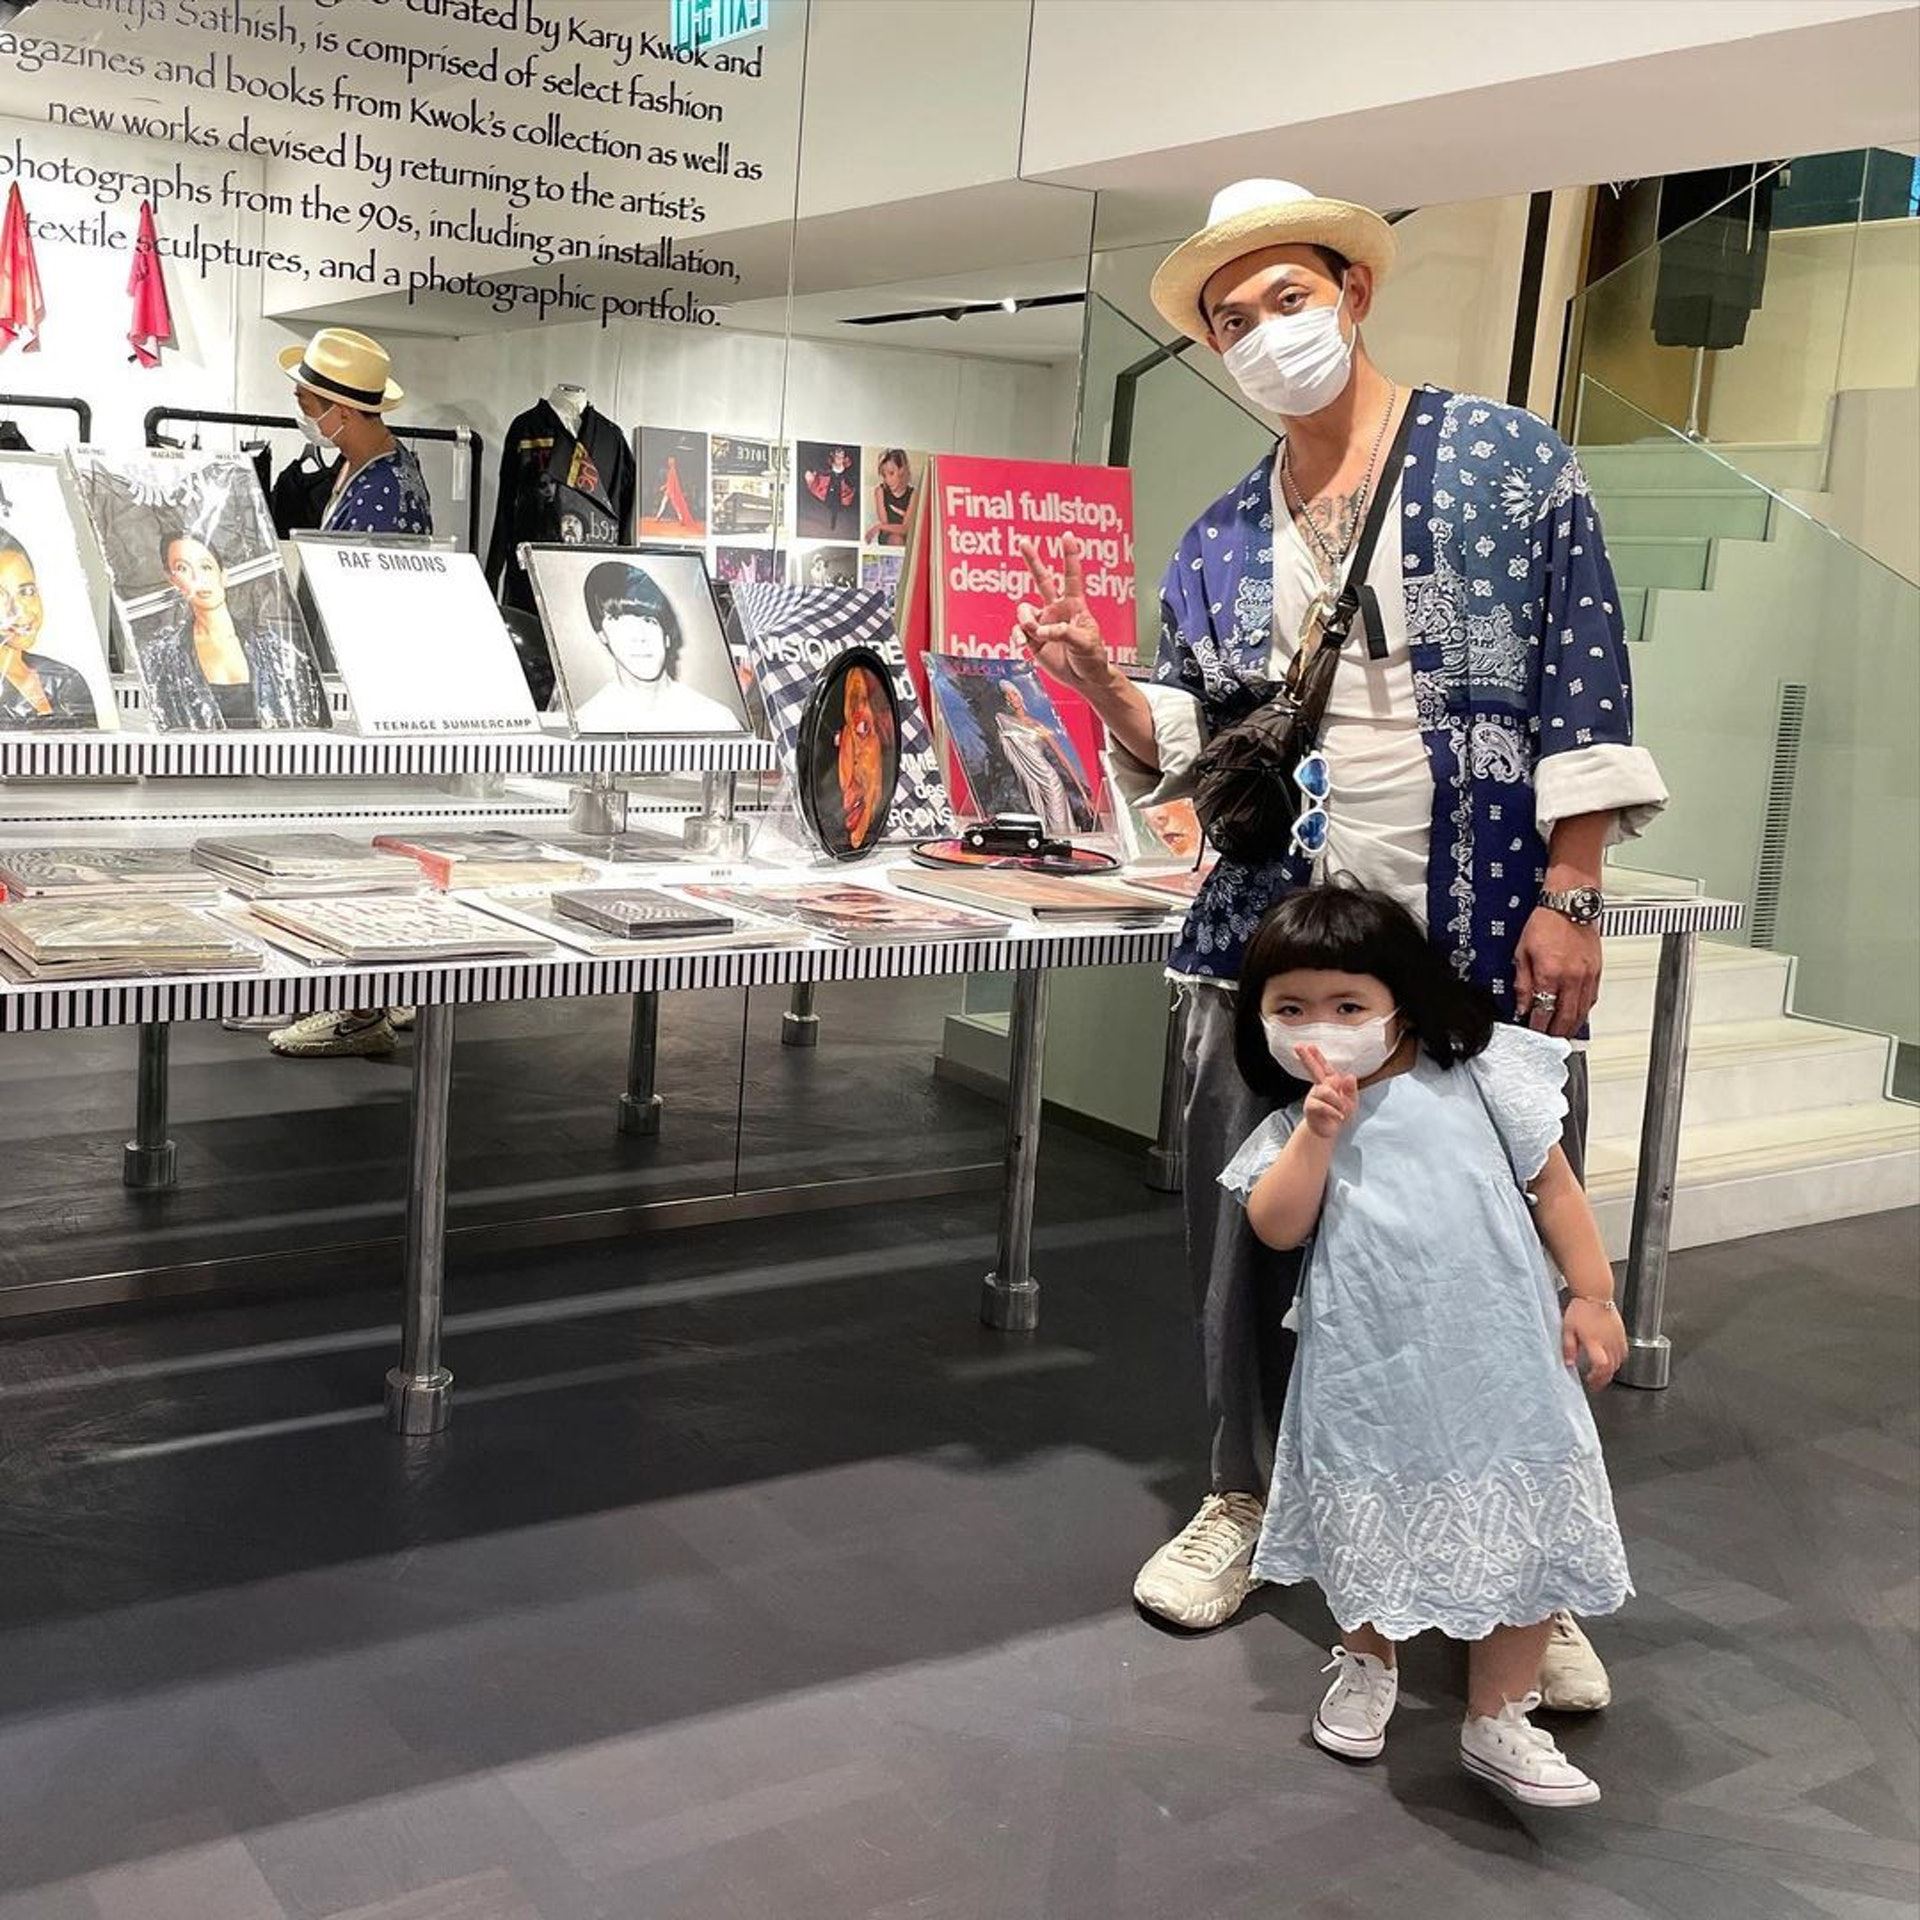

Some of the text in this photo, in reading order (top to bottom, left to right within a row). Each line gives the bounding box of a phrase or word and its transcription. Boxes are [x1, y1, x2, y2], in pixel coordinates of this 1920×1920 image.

[176, 0, 305, 53] Sathish,
[315, 21, 338, 52] is
[346, 36, 498, 83] comprised
[505, 55, 539, 88] of
[543, 64, 623, 104] select
[629, 74, 723, 122] fashion
[525, 0, 561, 52] by
[569, 18, 632, 65] Kary
[640, 31, 709, 68] Kwok
[714, 45, 762, 77] and
[153, 52, 216, 90] and
[226, 54, 325, 108] books
[333, 75, 400, 120] from
[410, 98, 506, 138] Kwok's
[513, 111, 641, 161] collection
[647, 146, 677, 167] as
[682, 142, 729, 176] well
[733, 159, 764, 181] as
[48, 101, 706, 223] new works devised by returning to the artist's
[220, 171, 292, 216] from
[301, 184, 351, 223] the
[357, 202, 420, 240] 90s,
[429, 207, 554, 265] including
[558, 236, 591, 259] an
[598, 234, 741, 283] installation,
[24, 210, 721, 329] textile sculptures, and a photographic portfolio.
[945, 485, 1123, 532] Final fullstop,
[948, 524, 1002, 556] text
[337, 550, 447, 573] RAF SIMONS
[373, 718, 533, 731] TEENAGE SUMMERCAMP
[914, 782, 946, 800] des
